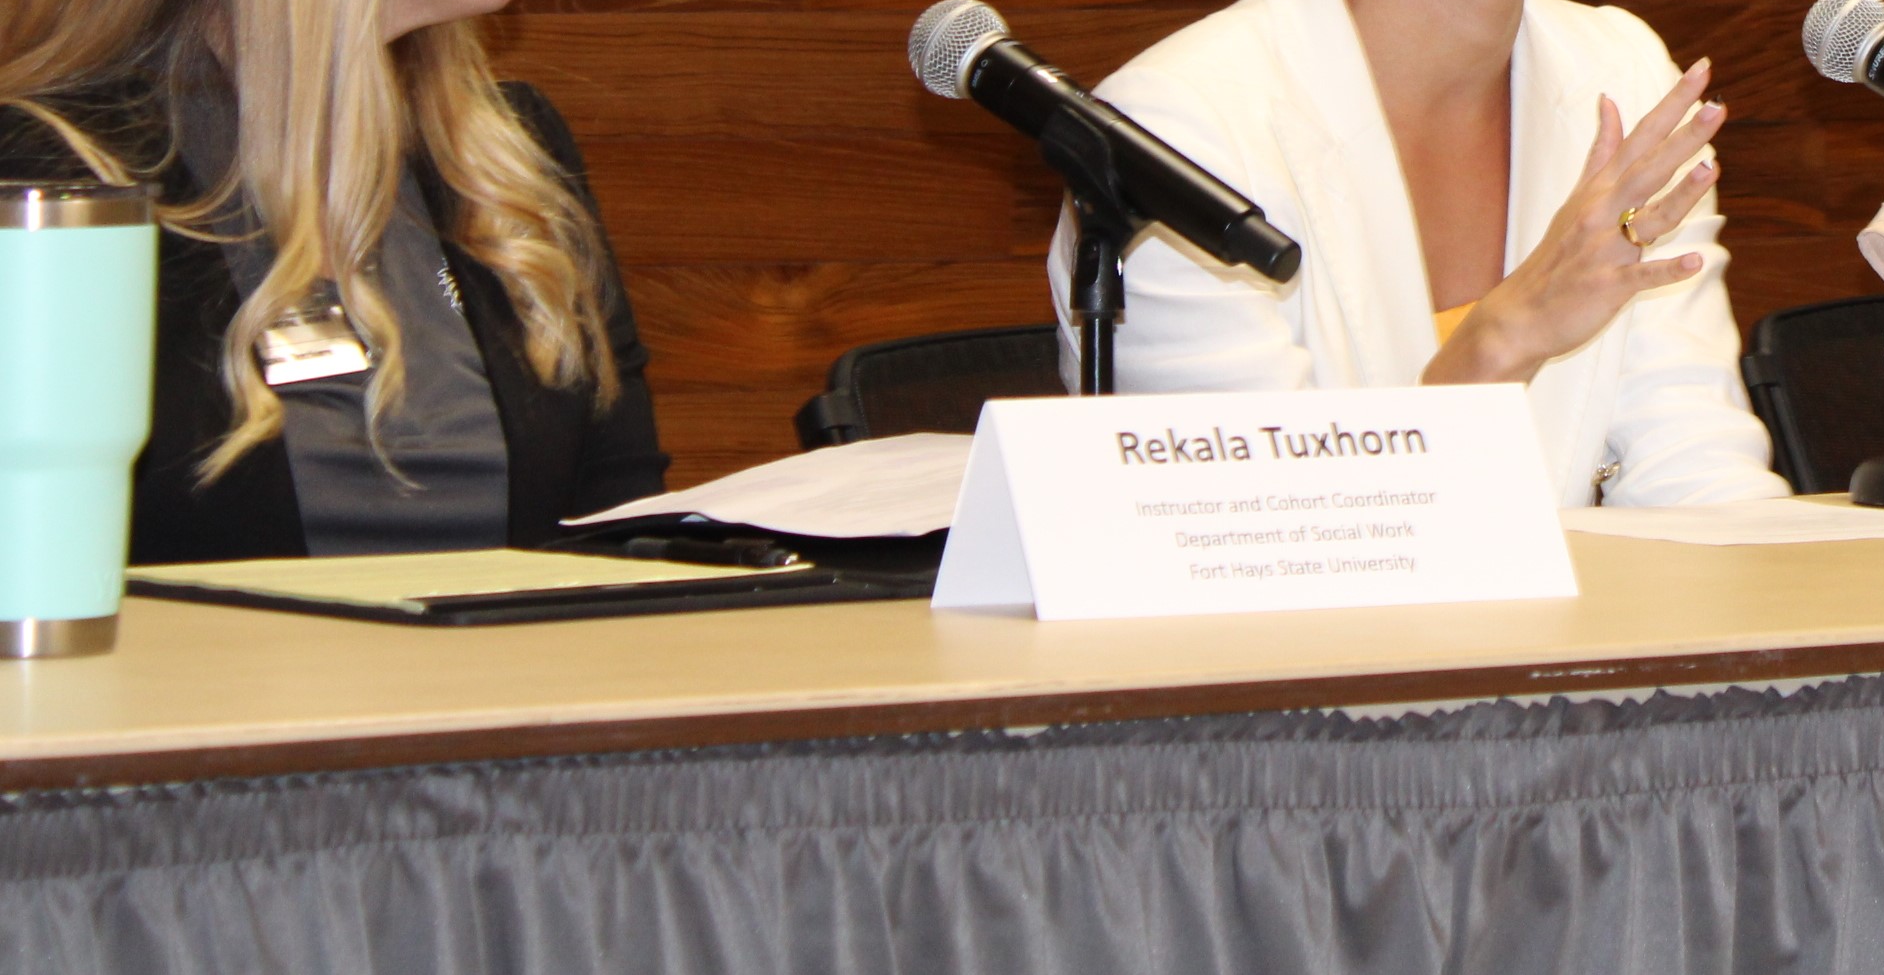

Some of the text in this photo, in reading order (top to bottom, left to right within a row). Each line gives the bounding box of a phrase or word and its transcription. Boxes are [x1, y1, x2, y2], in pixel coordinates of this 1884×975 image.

[1114, 421, 1428, 466] Rekala Tuxhorn
[1135, 489, 1437, 518] Instructor and Cohort Coordinator
[1174, 520, 1416, 550] Department of Social Work
[1189, 554, 1416, 581] Fort Hays State University
